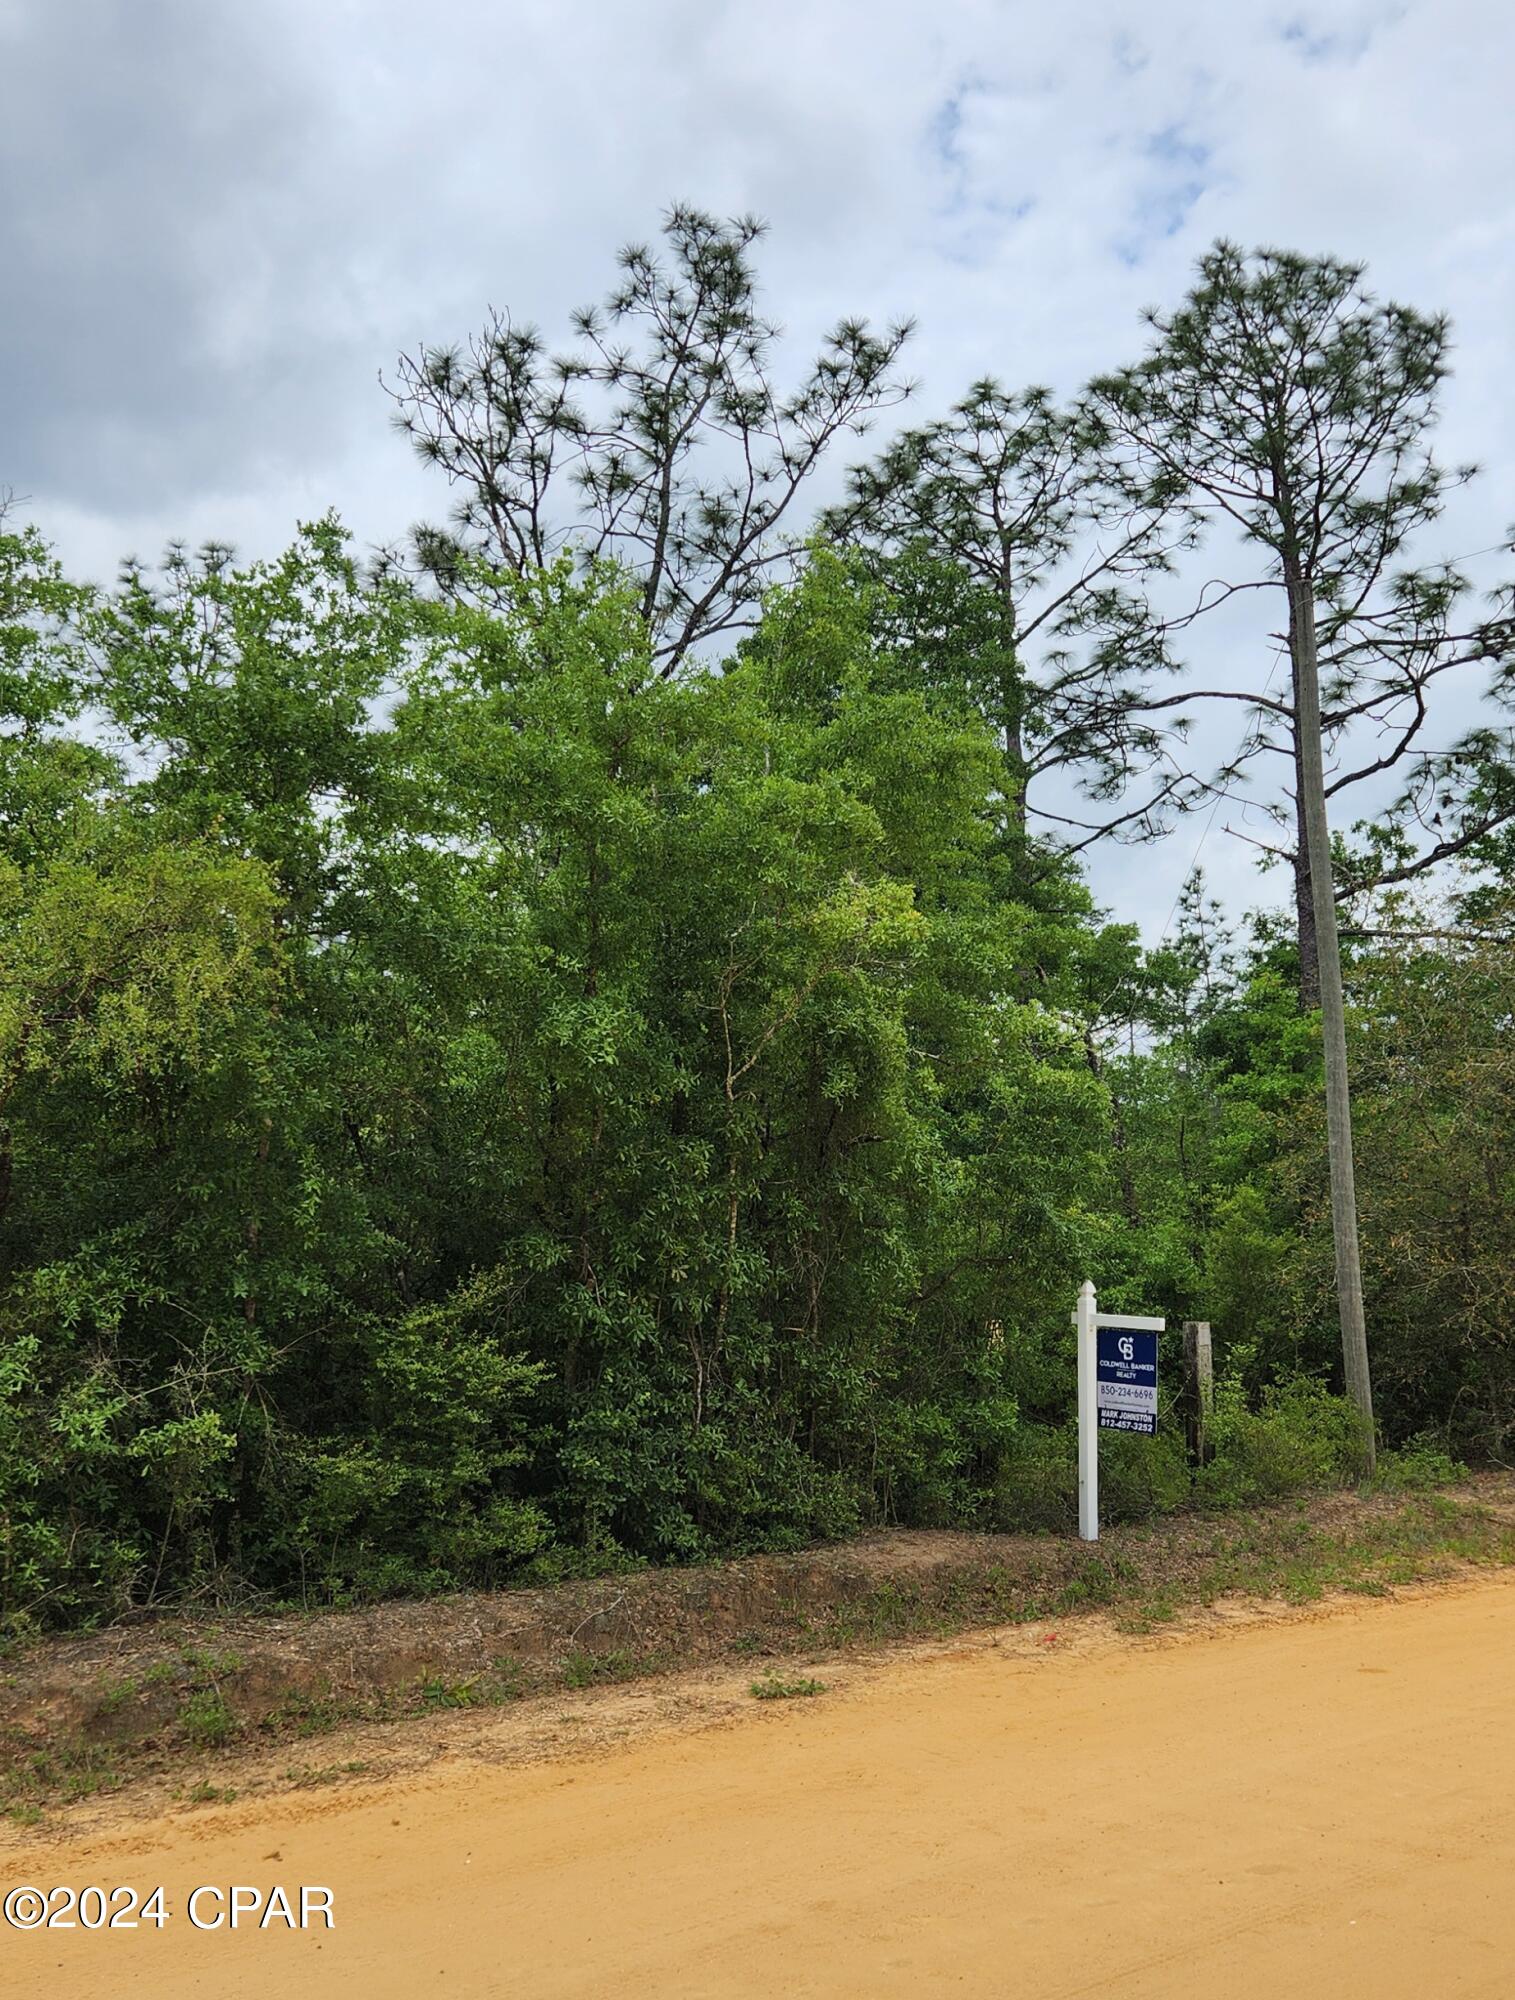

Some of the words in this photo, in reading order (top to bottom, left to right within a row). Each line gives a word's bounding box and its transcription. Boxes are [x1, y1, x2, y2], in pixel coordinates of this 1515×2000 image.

[1099, 1360, 1130, 1369] COLDWELL
[1130, 1362, 1155, 1372] BANKER
[1116, 1371, 1137, 1379] REALTY
[1101, 1385, 1153, 1400] 850-234-6696
[1101, 1409, 1118, 1419] MARK
[1119, 1411, 1153, 1423] JOHNSTON
[1100, 1418, 1153, 1433] 812-457-3252
